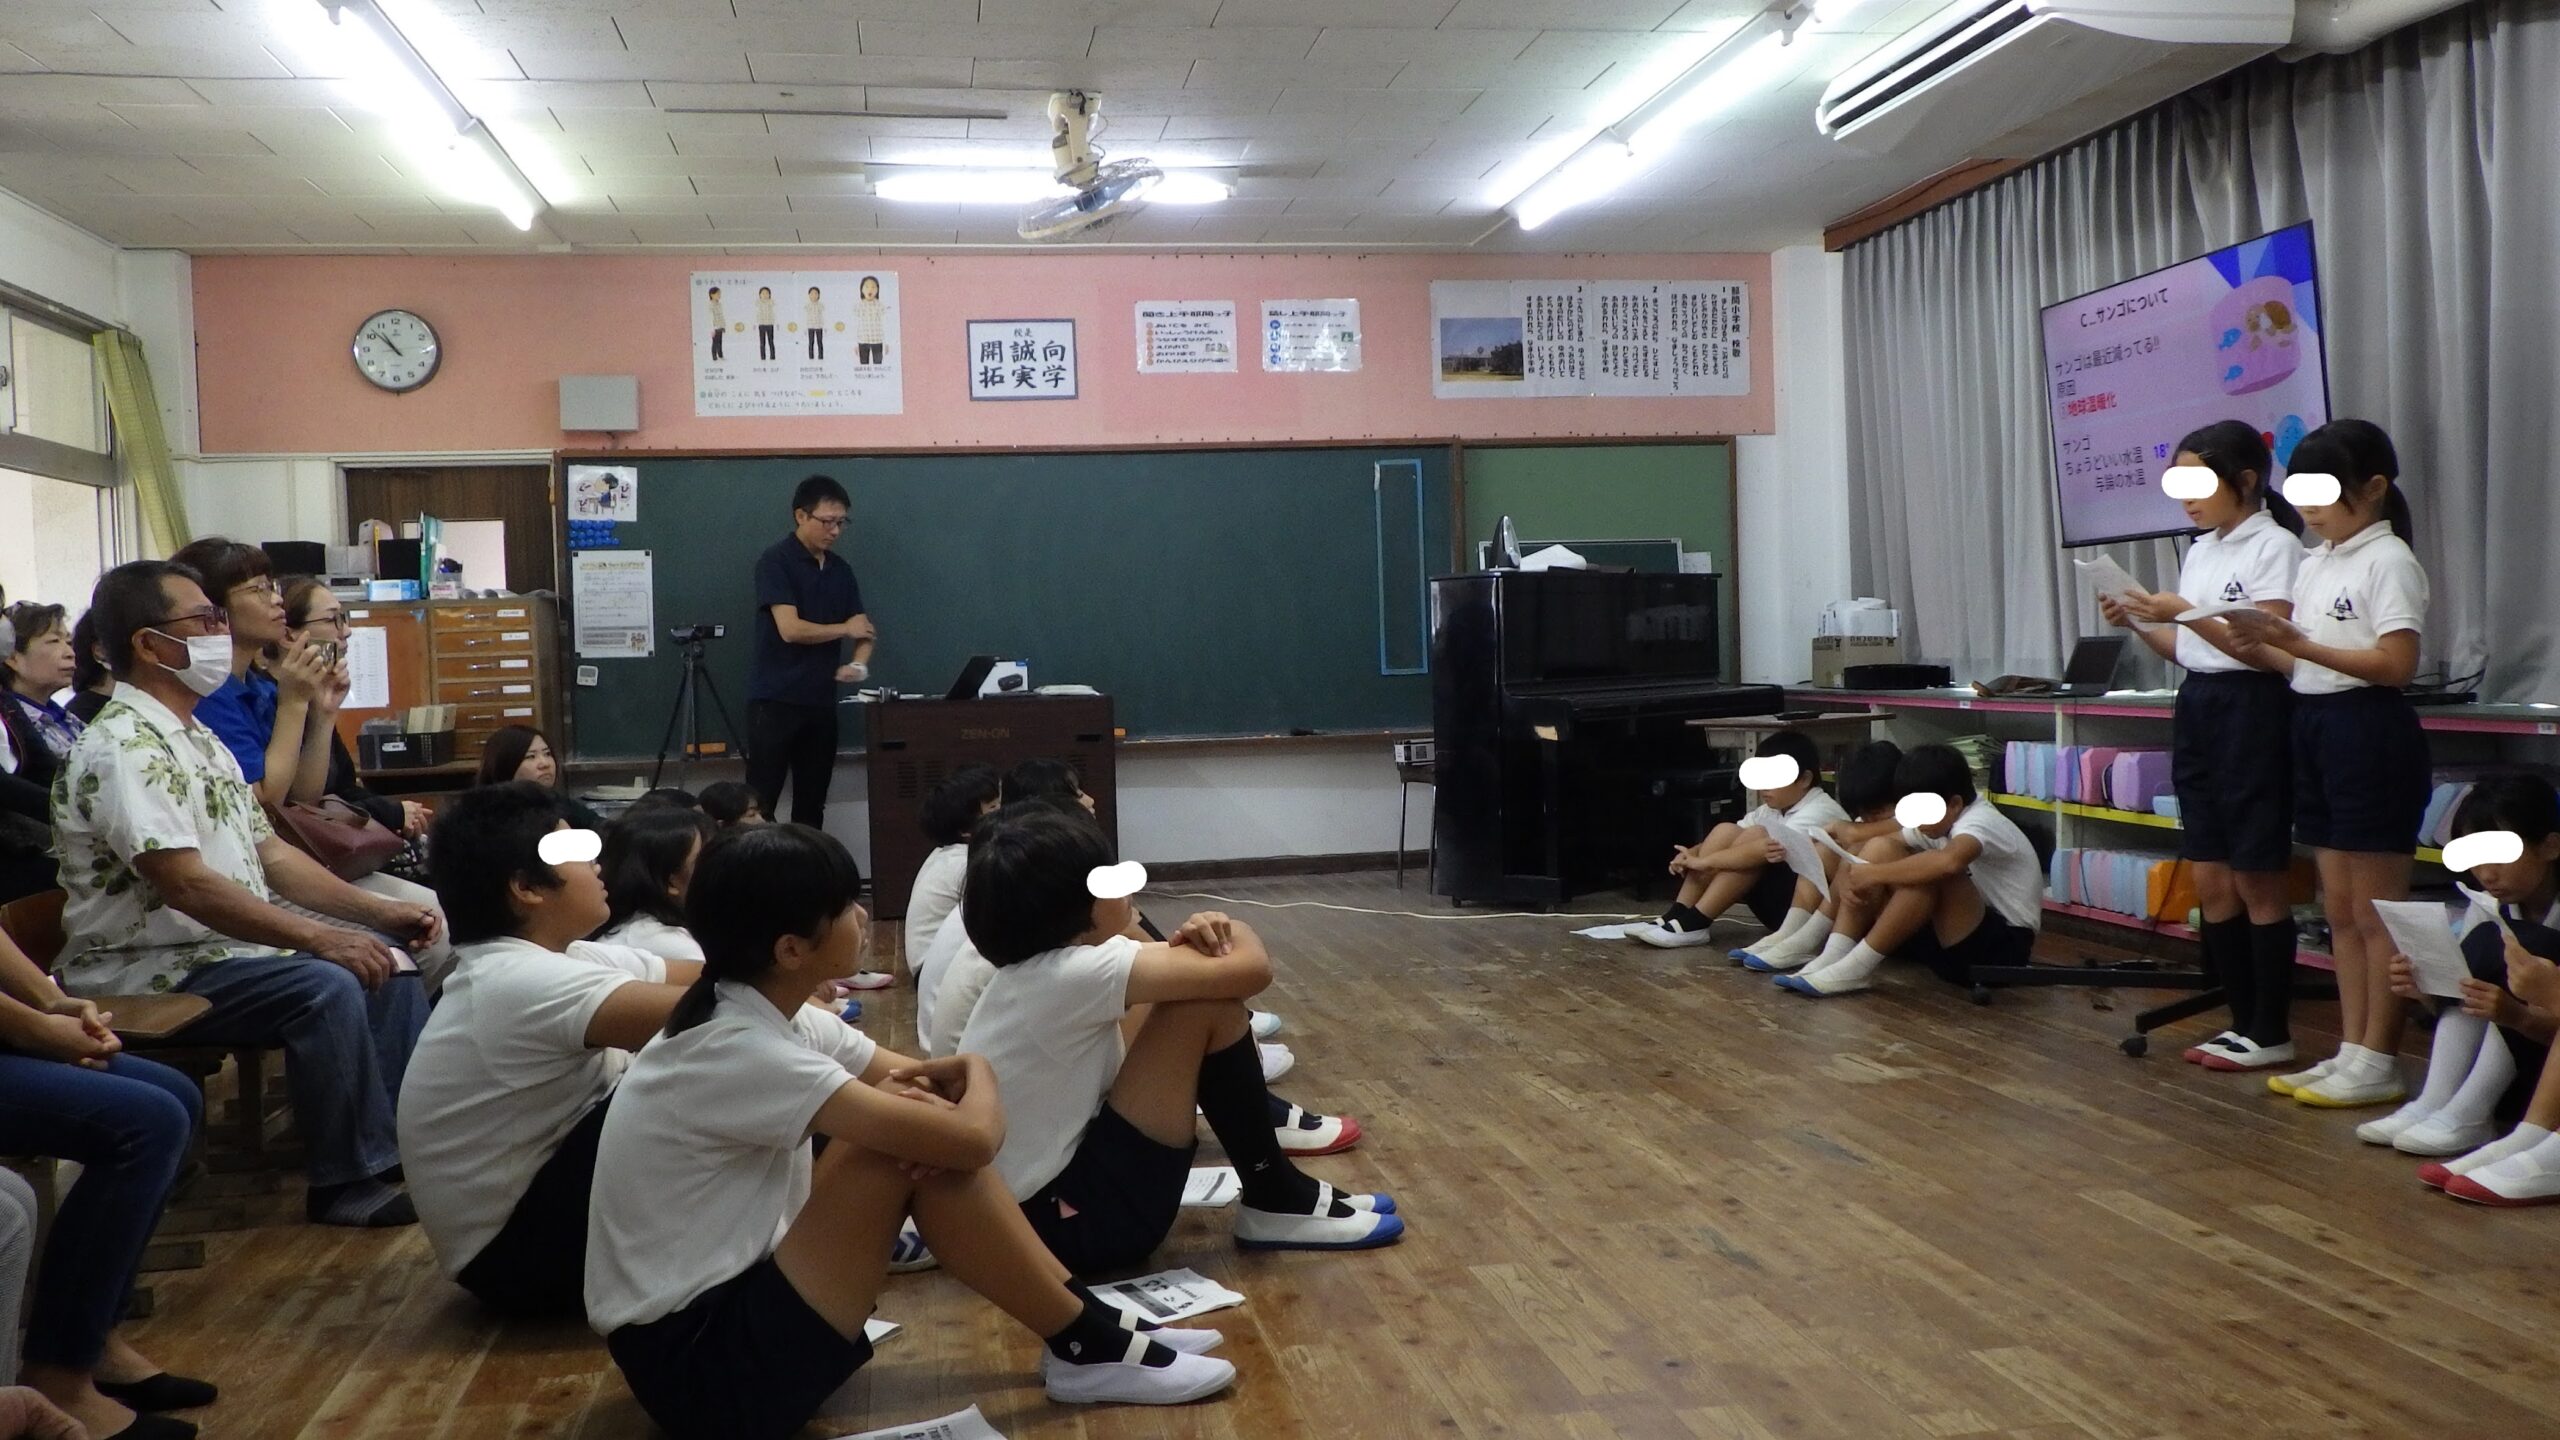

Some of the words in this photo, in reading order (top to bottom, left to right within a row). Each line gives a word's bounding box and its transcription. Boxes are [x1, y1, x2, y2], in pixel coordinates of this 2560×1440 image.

[2063, 434, 2091, 454] サンゴ
[961, 728, 1009, 739] ZEN-ON
